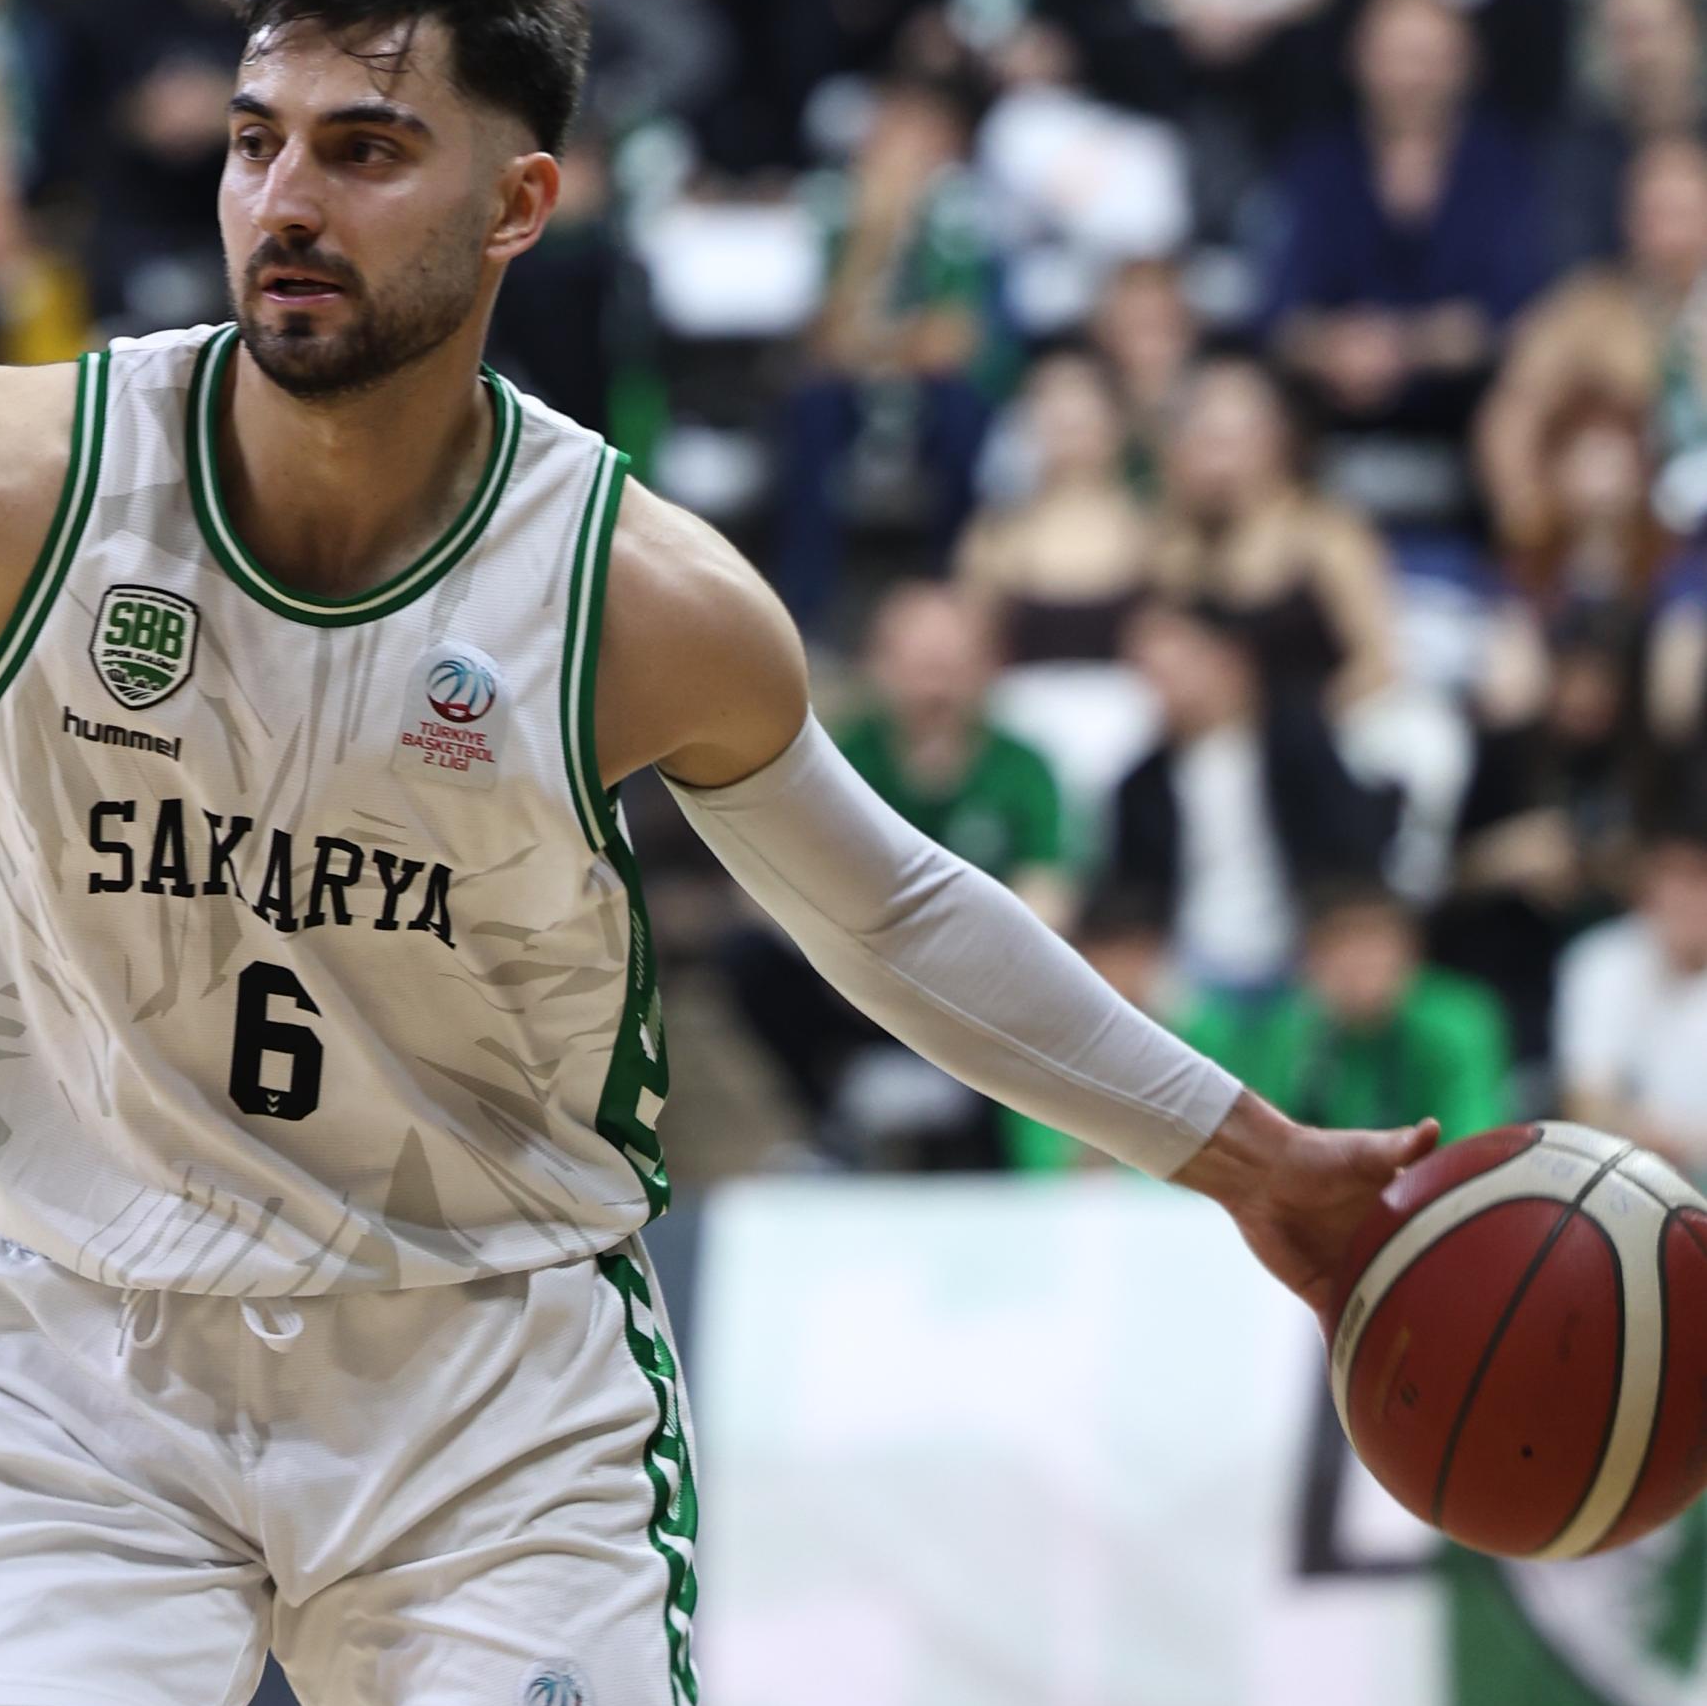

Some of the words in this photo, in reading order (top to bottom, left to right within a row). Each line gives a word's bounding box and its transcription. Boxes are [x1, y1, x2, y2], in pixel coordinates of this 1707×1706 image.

[104, 601, 186, 660] SBB
[62, 705, 183, 762] hummel
[401, 732, 496, 763] BASKETBOL
[88, 798, 456, 950] SAKARYA
[229, 960, 324, 1121] 6
